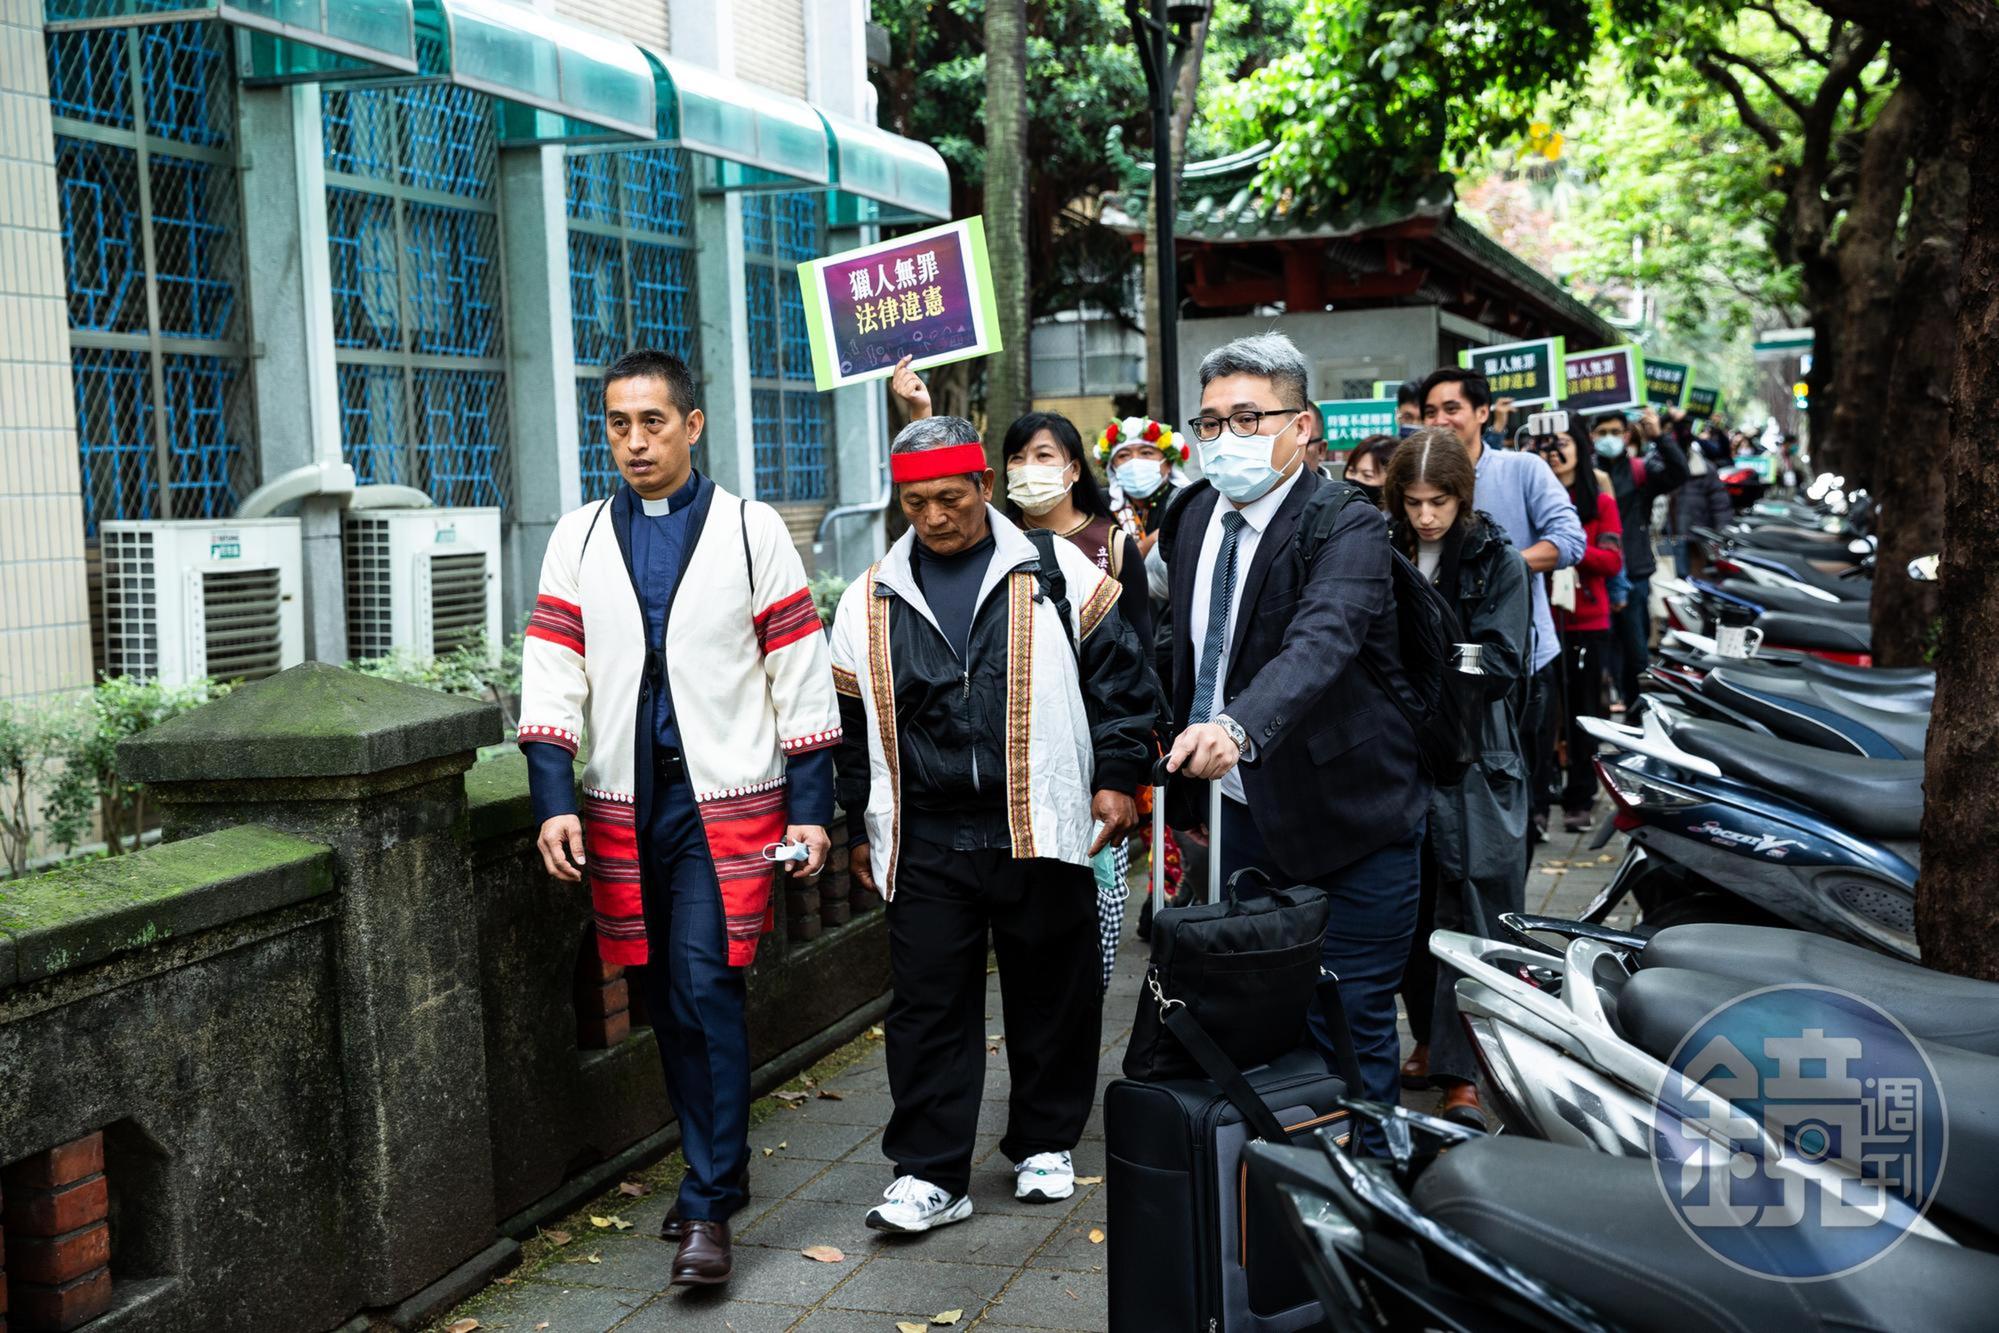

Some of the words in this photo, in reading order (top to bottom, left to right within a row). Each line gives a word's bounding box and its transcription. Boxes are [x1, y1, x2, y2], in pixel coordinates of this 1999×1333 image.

[848, 250, 940, 301] 獵人無罪
[855, 285, 945, 335] 法律違憲
[1097, 546, 1109, 572] 立法
